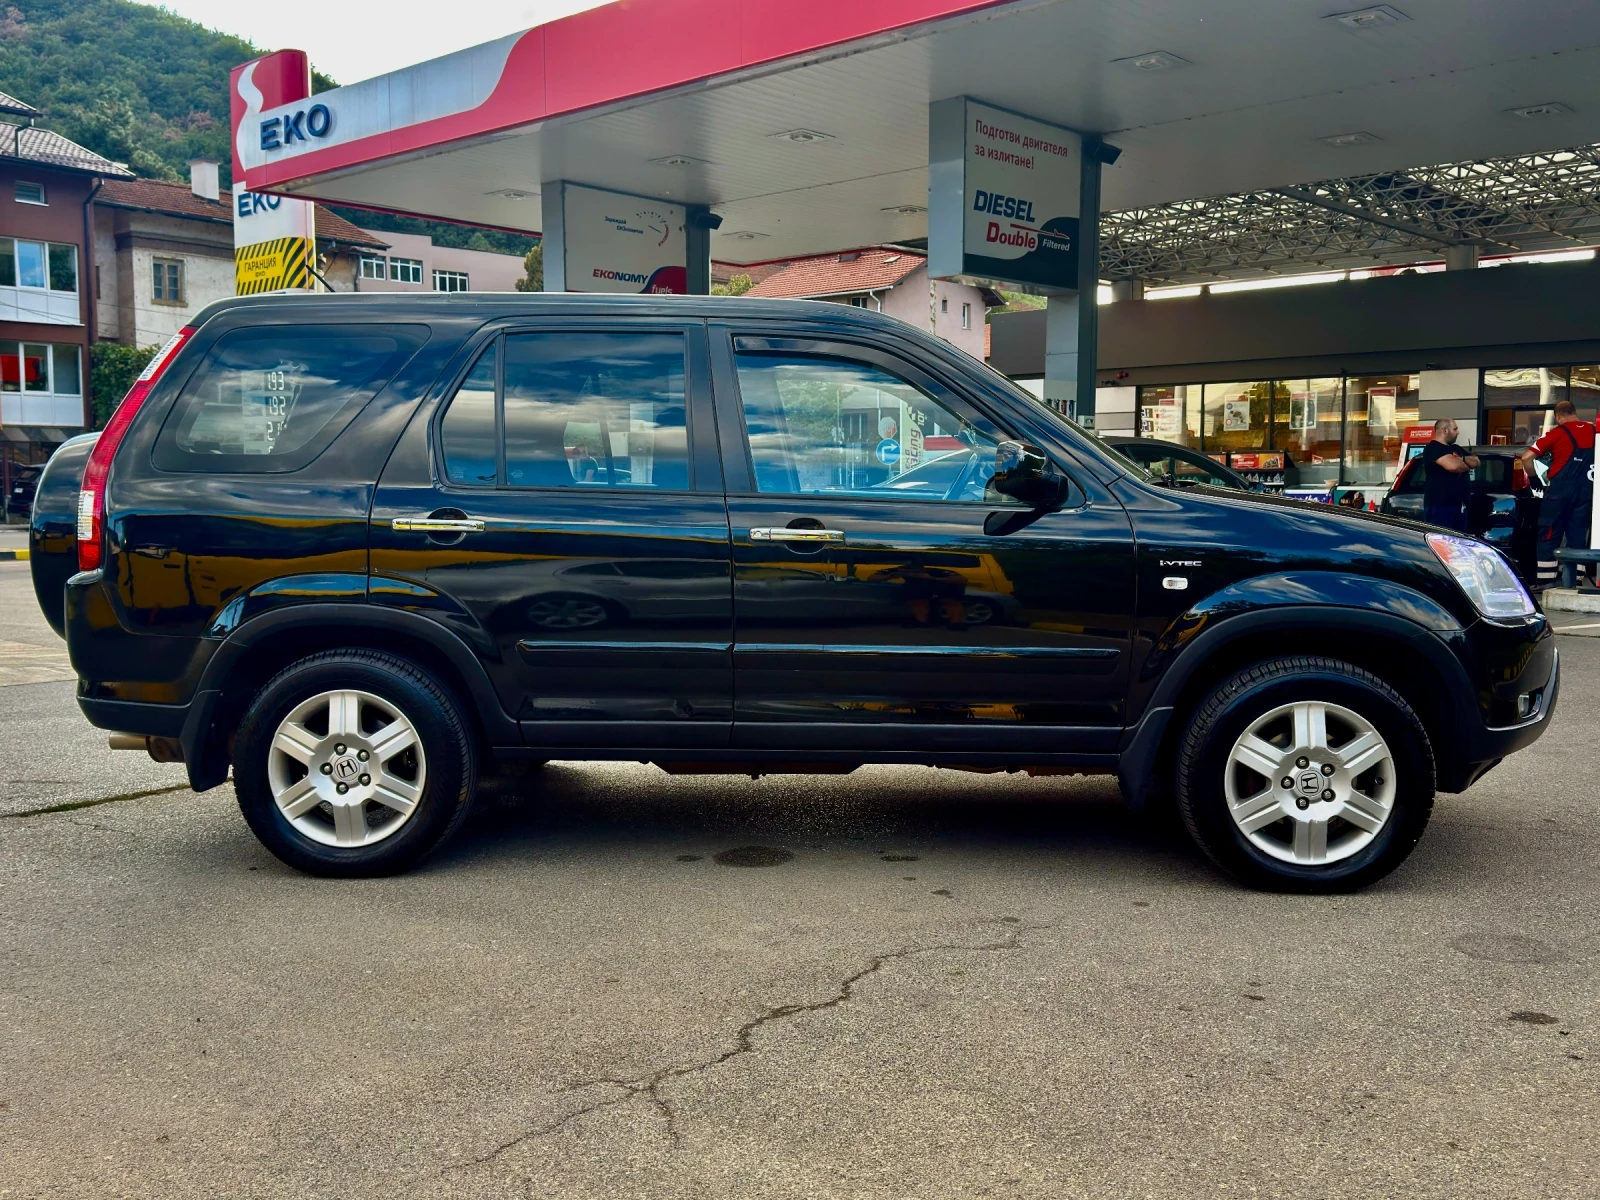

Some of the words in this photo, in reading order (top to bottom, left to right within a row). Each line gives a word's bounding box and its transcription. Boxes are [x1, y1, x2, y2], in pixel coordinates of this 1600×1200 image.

[260, 103, 331, 151] EKO
[975, 119, 1020, 144] Подготви
[1022, 136, 1068, 158] двигателя
[974, 144, 985, 156] за
[988, 147, 1034, 169] излитане!
[973, 189, 1036, 223] DIESEL
[986, 221, 1036, 249] Double
[1042, 238, 1071, 252] Filtered
[244, 256, 277, 273] ГАРАНЦИЯ
[592, 268, 649, 284] EKONOMY
[651, 284, 673, 294] fuels
